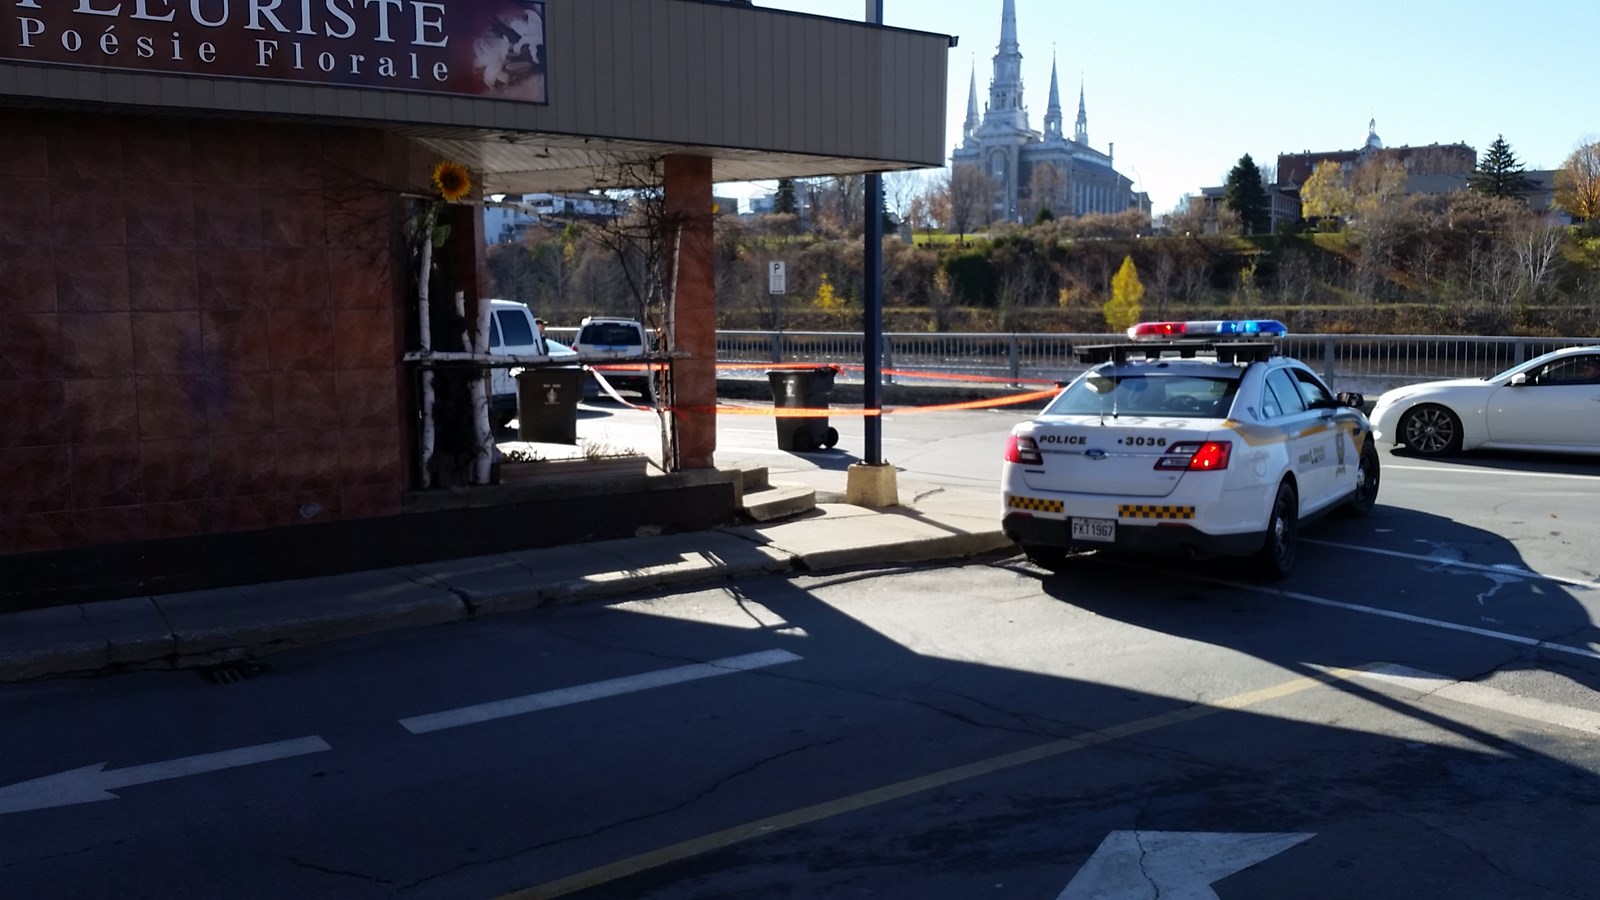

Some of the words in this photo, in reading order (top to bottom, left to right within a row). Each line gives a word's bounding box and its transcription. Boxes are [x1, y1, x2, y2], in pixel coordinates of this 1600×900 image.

[15, 0, 449, 48] URISTE
[16, 16, 216, 63] Poésie
[255, 39, 448, 81] Florale
[774, 263, 781, 274] P
[1039, 435, 1087, 445] POLICE
